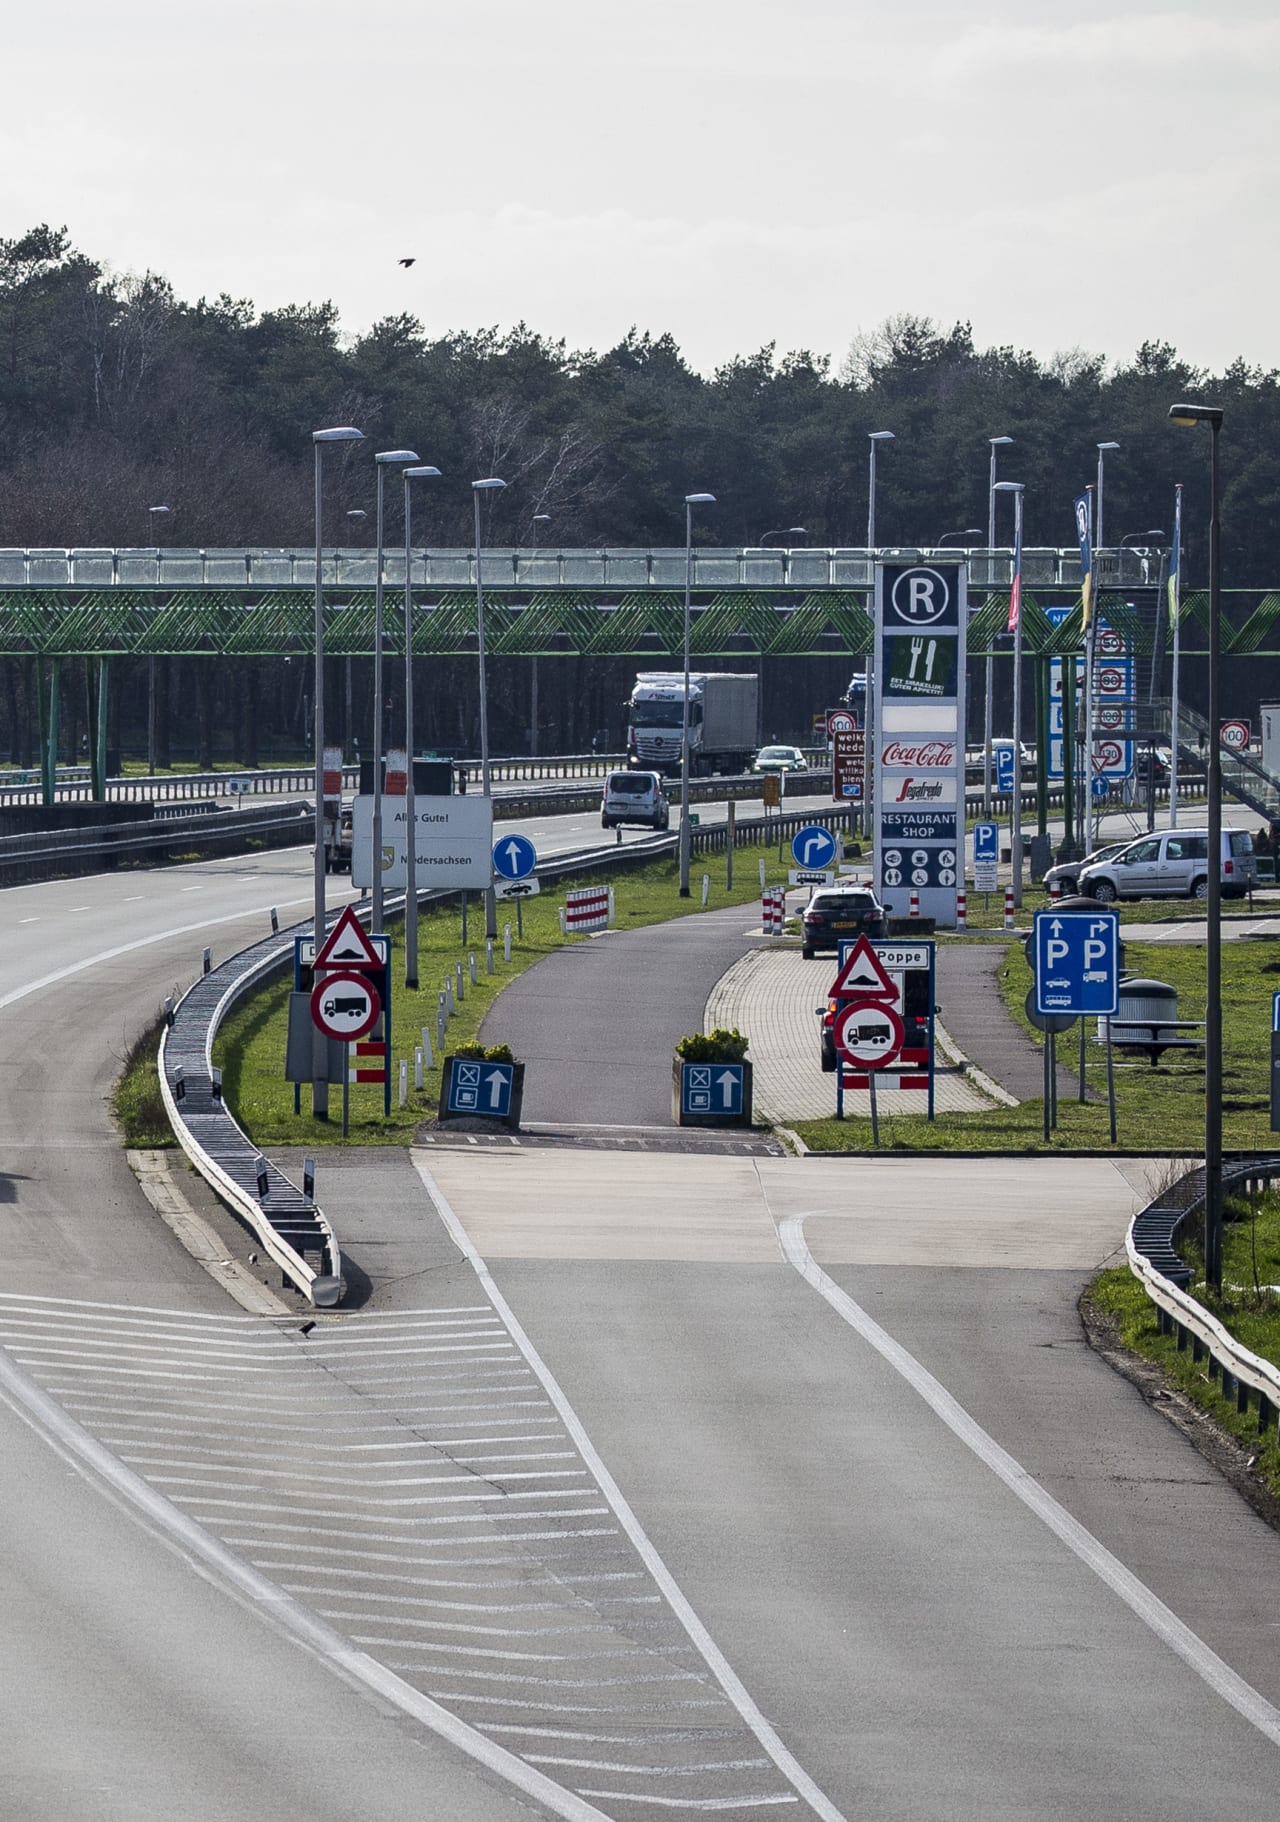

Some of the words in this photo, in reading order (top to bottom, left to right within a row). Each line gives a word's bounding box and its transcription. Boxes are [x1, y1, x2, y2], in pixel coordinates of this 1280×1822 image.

[909, 578, 935, 613] R
[881, 742, 957, 767] Coca-Cola
[999, 751, 1012, 768] P
[421, 813, 449, 823] Gute!
[881, 814, 956, 825] RESTAURANT
[902, 826, 935, 838] SHOP
[979, 826, 993, 846] P
[877, 951, 921, 963] Poppe
[1047, 939, 1069, 969] P
[1084, 939, 1107, 969] P
